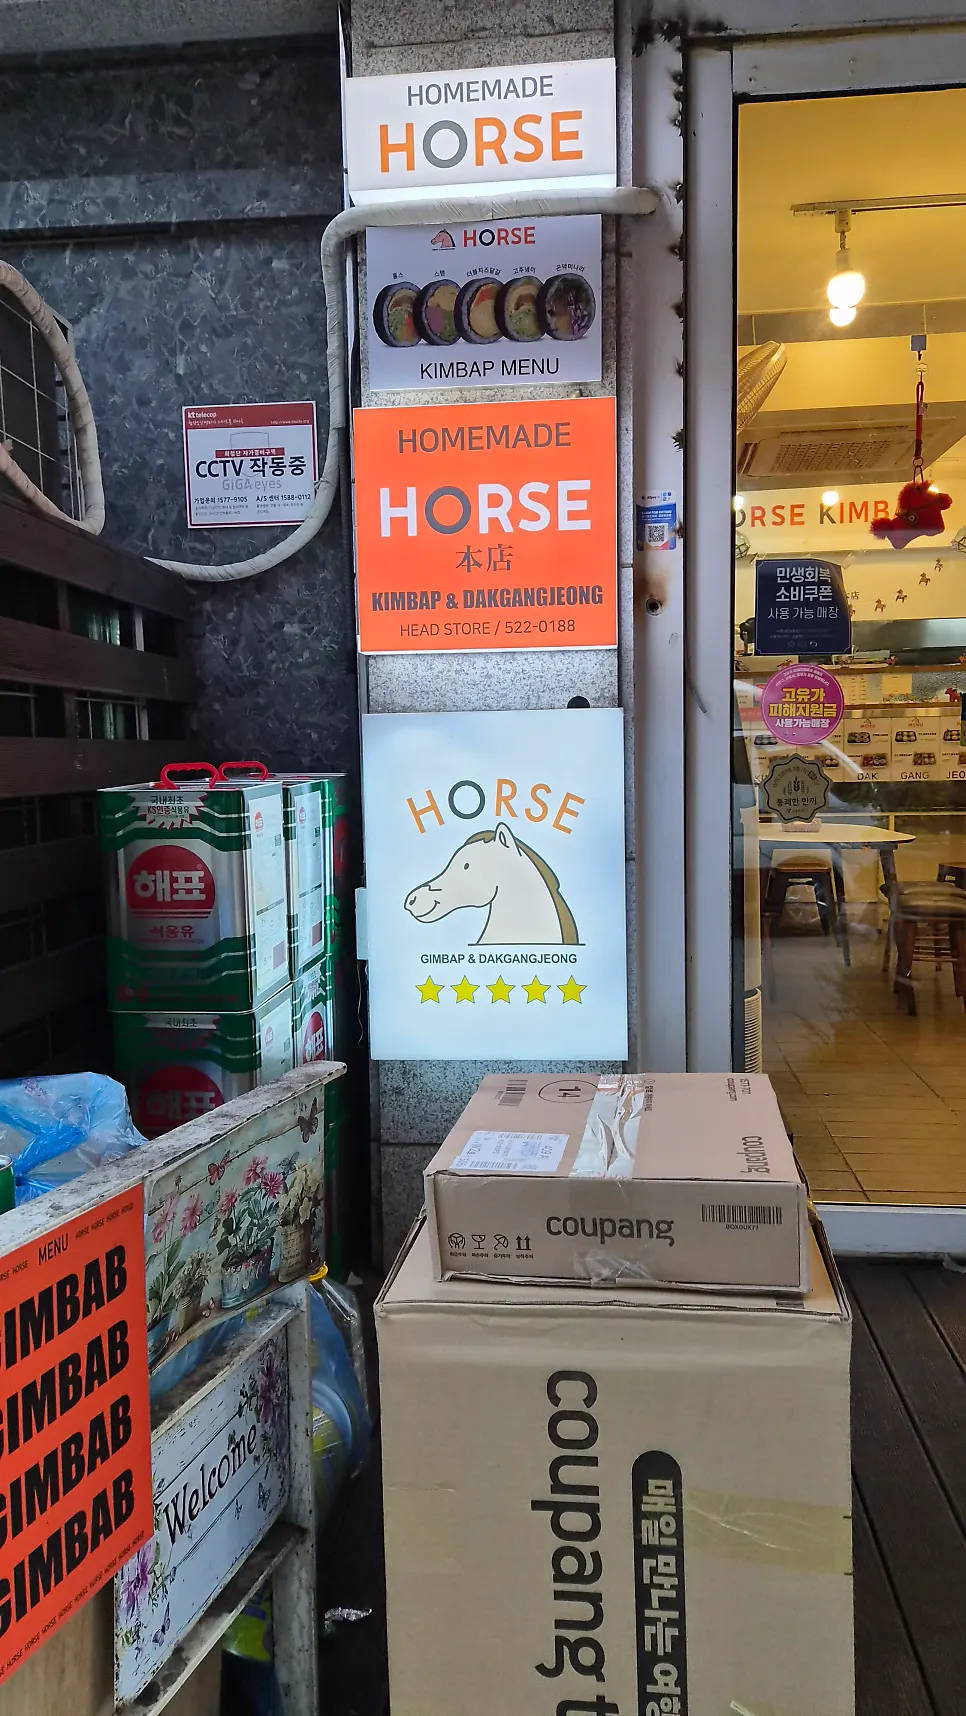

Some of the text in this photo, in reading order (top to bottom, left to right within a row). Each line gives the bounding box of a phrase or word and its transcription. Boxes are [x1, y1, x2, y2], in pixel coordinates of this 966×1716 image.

[407, 75, 554, 107] HOMEMADE
[379, 110, 583, 173] HORSE
[463, 226, 536, 247] HORSE
[420, 357, 560, 380] KIMBAP MENU
[398, 421, 571, 453] HOMEMADE
[195, 456, 307, 478] CCTV 작동중
[379, 479, 591, 538] HORSE
[455, 543, 514, 573] 本店
[776, 566, 832, 583] 민생회복
[371, 585, 603, 612] KIMBAP & DAKGANGJEONG
[775, 585, 833, 602] 소비쿠폰
[400, 619, 576, 637] HEAD STORE / 522-0188
[768, 606, 840, 620] 사용 가능 매장
[781, 687, 826, 702] 고유가
[768, 703, 837, 718] 피해지원금
[857, 772, 878, 781] DAK
[900, 771, 930, 780] GANG
[150, 795, 185, 805] 국내최초
[406, 778, 586, 835] HORSE
[801, 796, 817, 806] 한끼
[132, 870, 206, 902] 해표
[149, 925, 195, 939] 식용유
[420, 953, 578, 965] GIMBAP & DAKGANGJEONG
[736, 1135, 771, 1174] coupang
[545, 1215, 676, 1247] coupang
[38, 1233, 69, 1266] MENU
[0, 1245, 127, 1371] IMBAB
[0, 1320, 130, 1459] IMBAB
[163, 1424, 257, 1546] Welcome
[530, 1370, 606, 1683] coupang
[641, 1478, 678, 1546] 매일
[642, 1554, 680, 1656] 만나는
